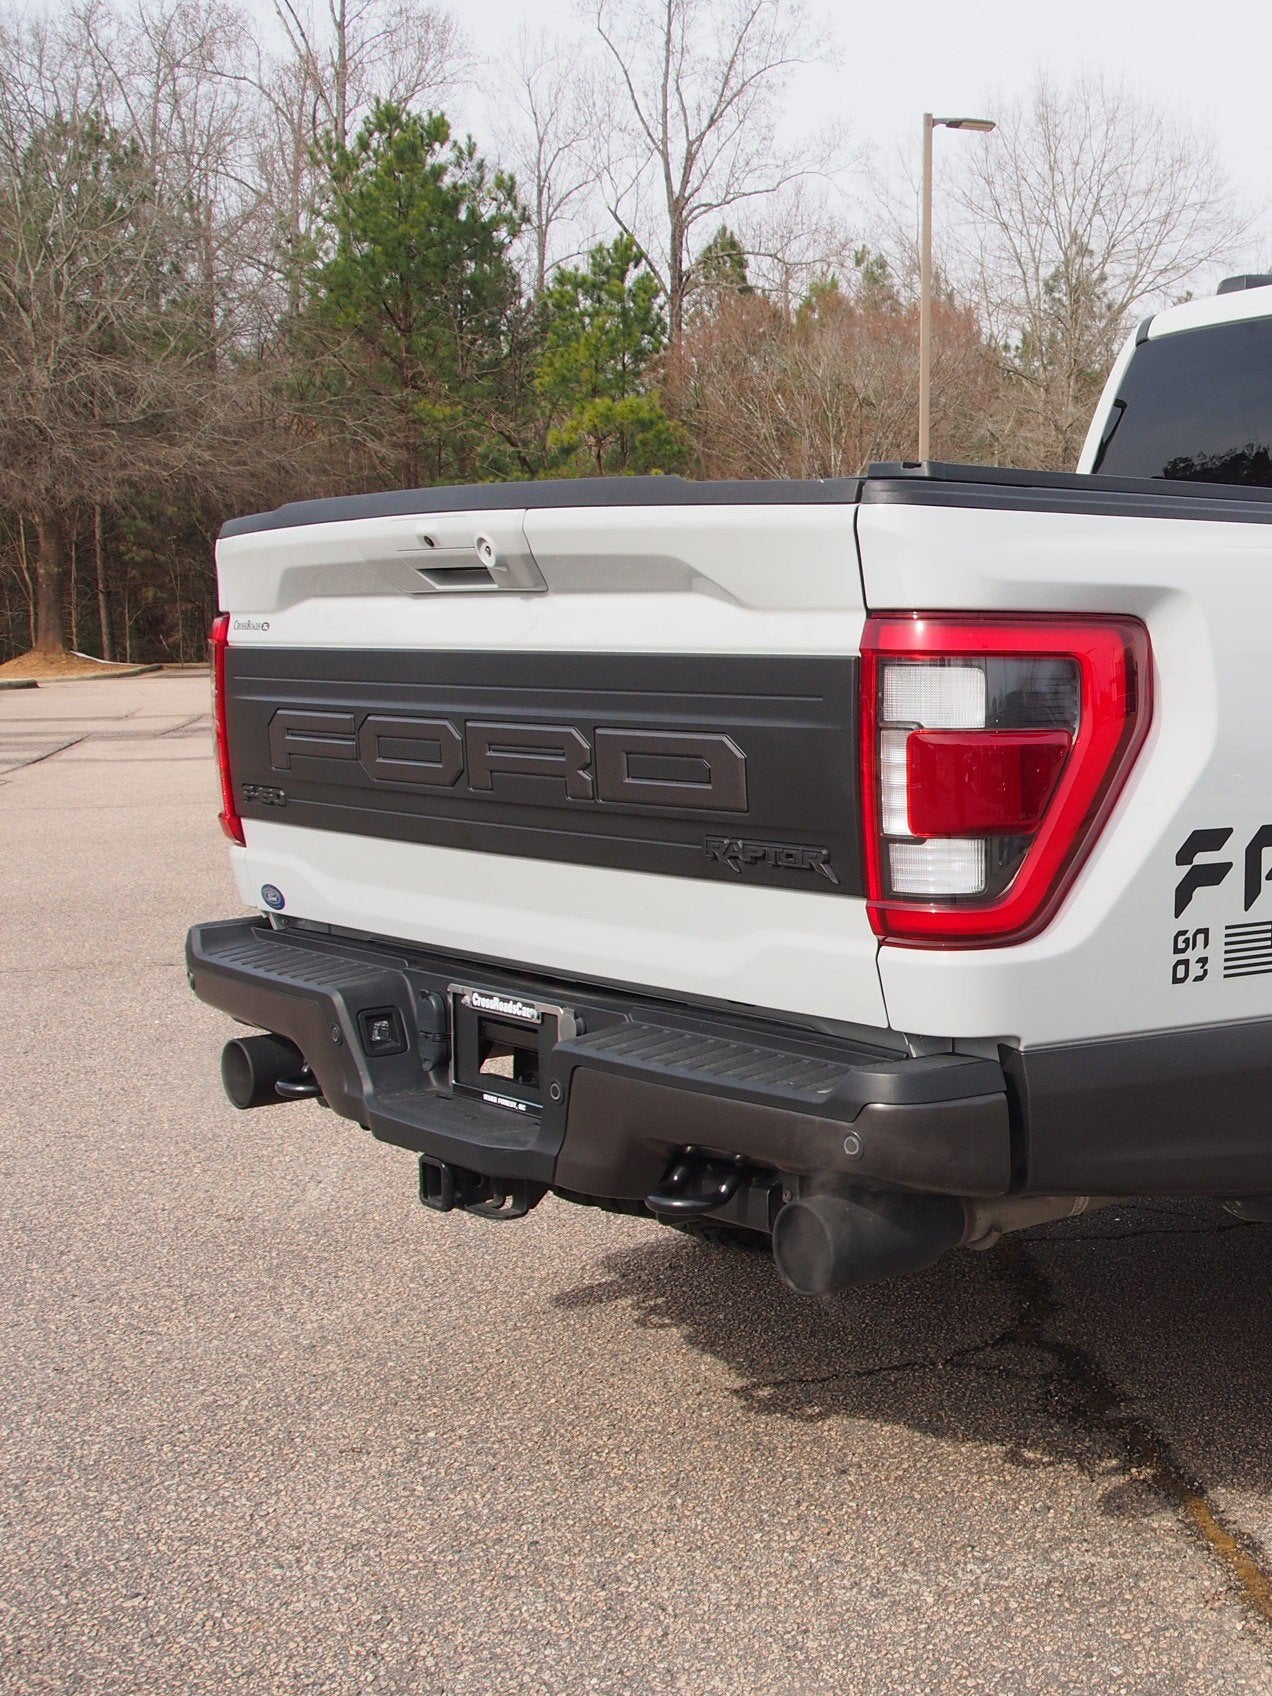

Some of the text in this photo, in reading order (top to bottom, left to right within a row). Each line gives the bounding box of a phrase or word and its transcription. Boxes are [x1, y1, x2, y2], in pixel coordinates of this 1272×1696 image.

[268, 707, 749, 813] FORD
[704, 834, 840, 885] RAPTOR
[472, 993, 536, 1019] CrossRoadsCar
